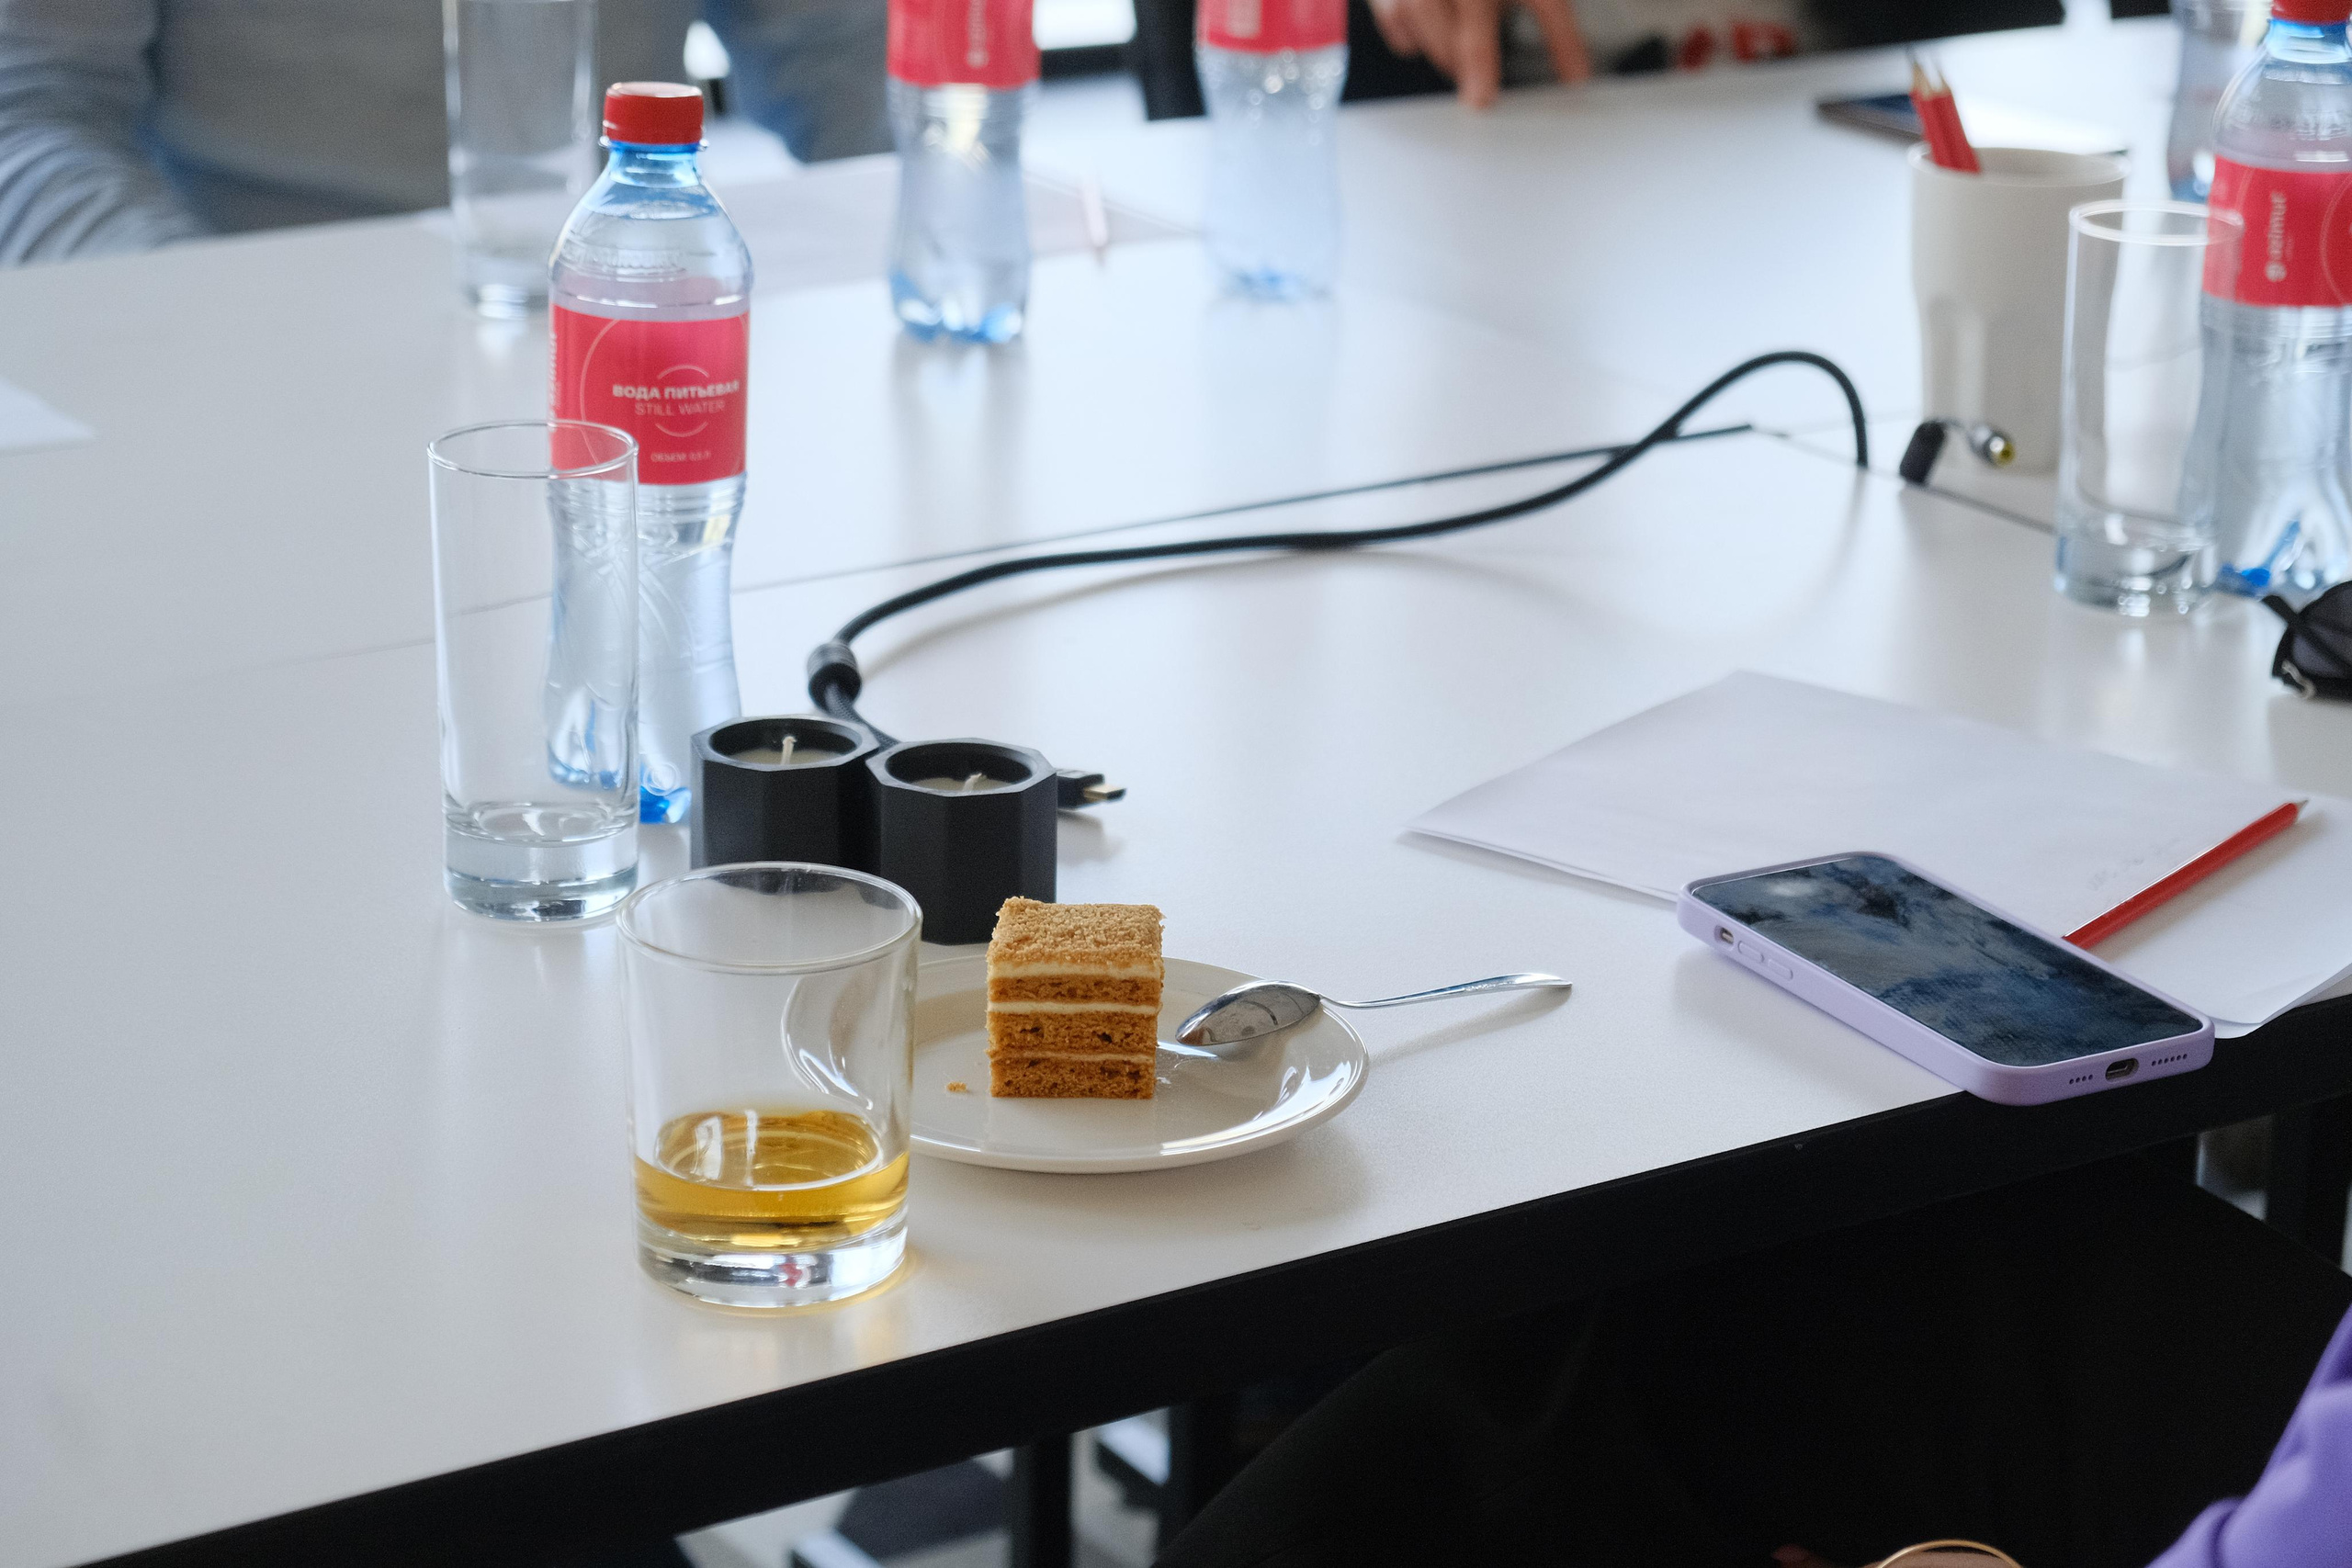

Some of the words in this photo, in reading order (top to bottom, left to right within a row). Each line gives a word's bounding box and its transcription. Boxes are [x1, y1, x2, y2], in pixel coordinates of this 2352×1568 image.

[612, 383, 661, 400] ВОДА
[663, 380, 740, 400] ПИТЬЕВАЯ
[634, 401, 674, 416] STILL
[678, 399, 726, 415] WATER
